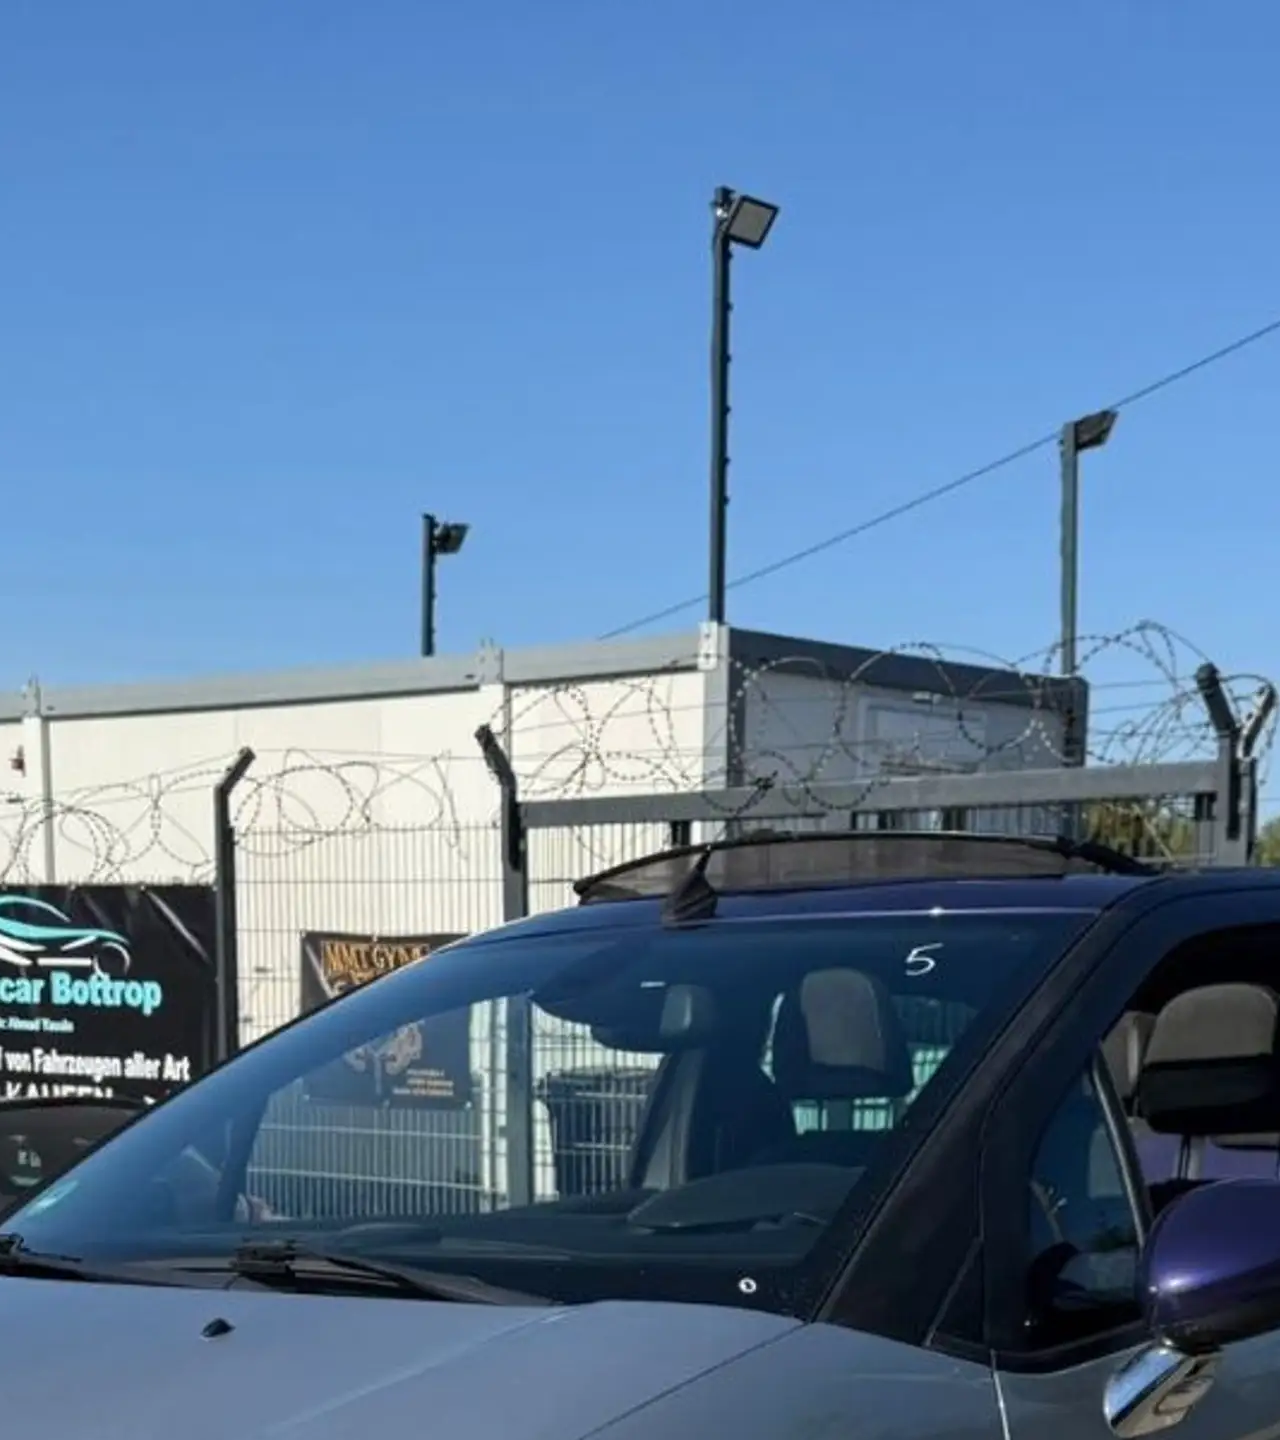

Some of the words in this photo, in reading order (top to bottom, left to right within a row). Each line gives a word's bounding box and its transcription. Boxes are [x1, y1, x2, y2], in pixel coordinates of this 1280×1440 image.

[904, 941, 944, 977] 5
[49, 970, 162, 1016] Bottrop
[5, 1051, 31, 1072] von
[32, 1047, 122, 1083] Fahrzeugen
[124, 1052, 160, 1079] aller
[162, 1053, 191, 1082] Art
